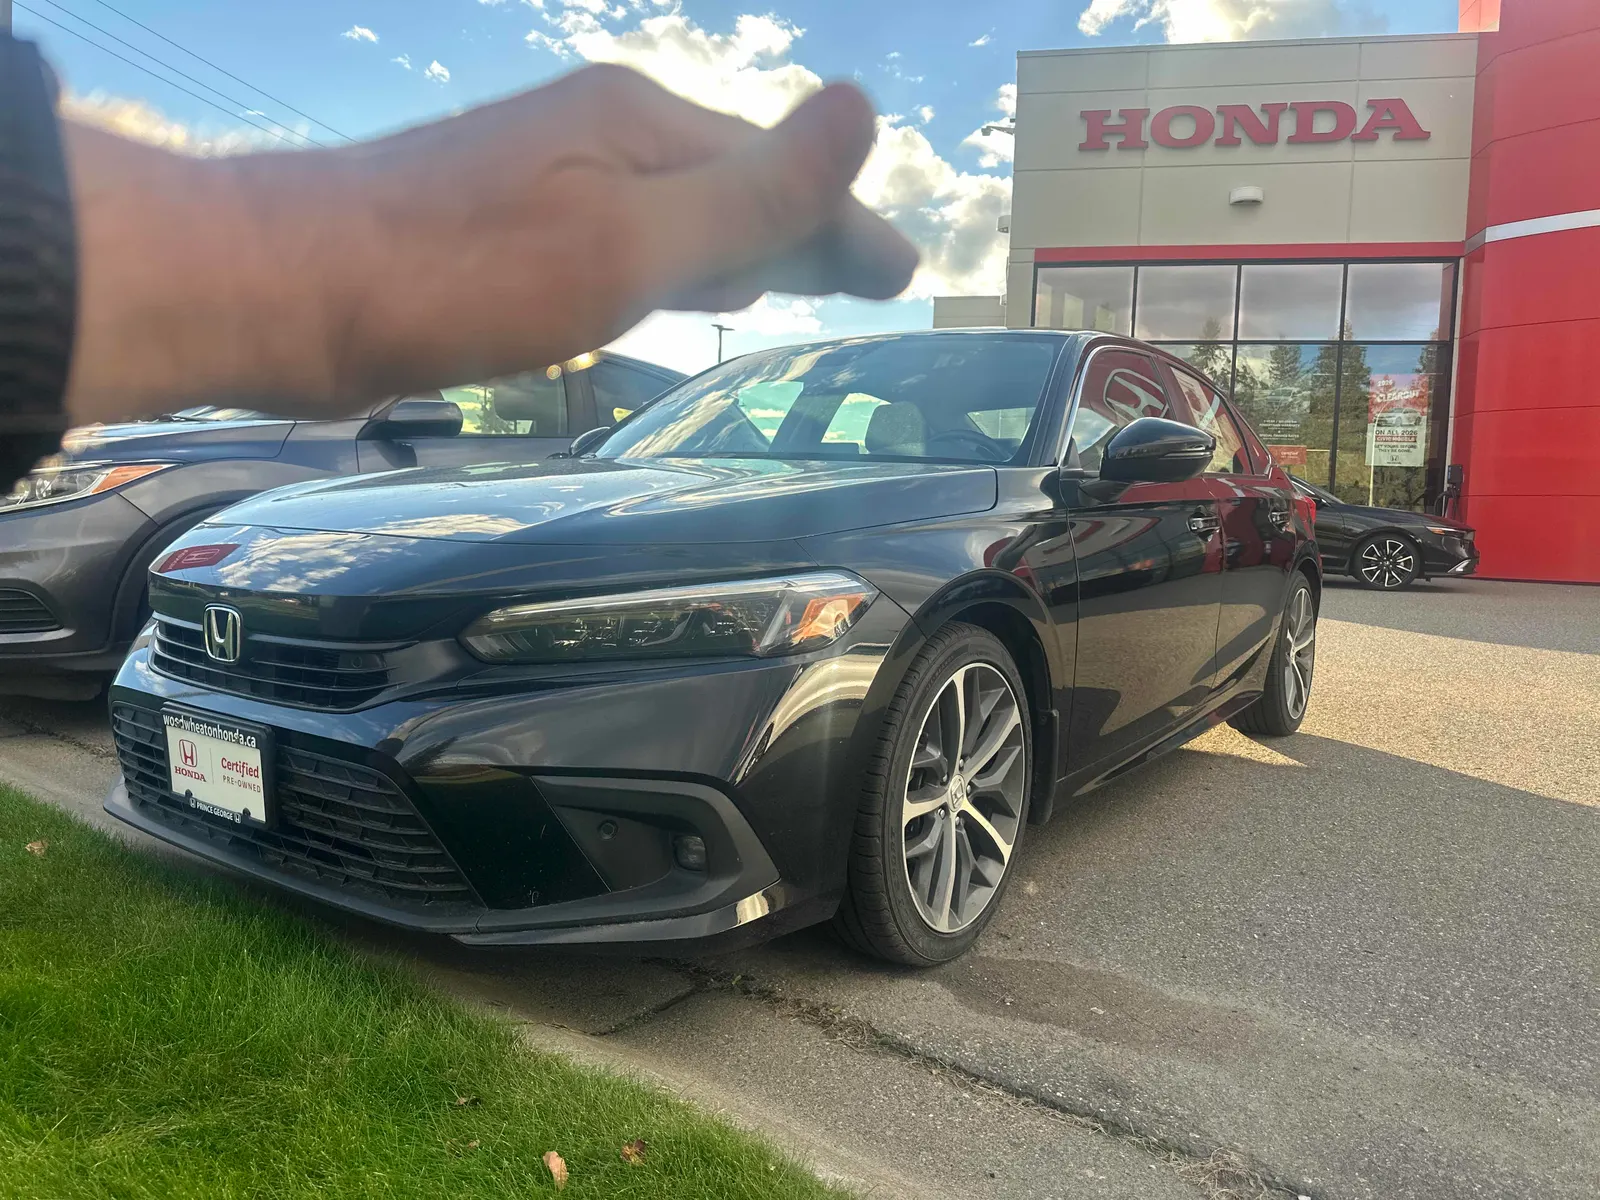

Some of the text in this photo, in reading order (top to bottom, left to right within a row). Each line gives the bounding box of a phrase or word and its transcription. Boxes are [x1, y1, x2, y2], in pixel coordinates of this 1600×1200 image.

[1078, 97, 1431, 151] HONDA
[174, 765, 207, 783] HONDA
[221, 757, 260, 779] Certified
[222, 774, 261, 793] PRE-OWNED
[196, 801, 234, 821] PRINCE GEORGE
